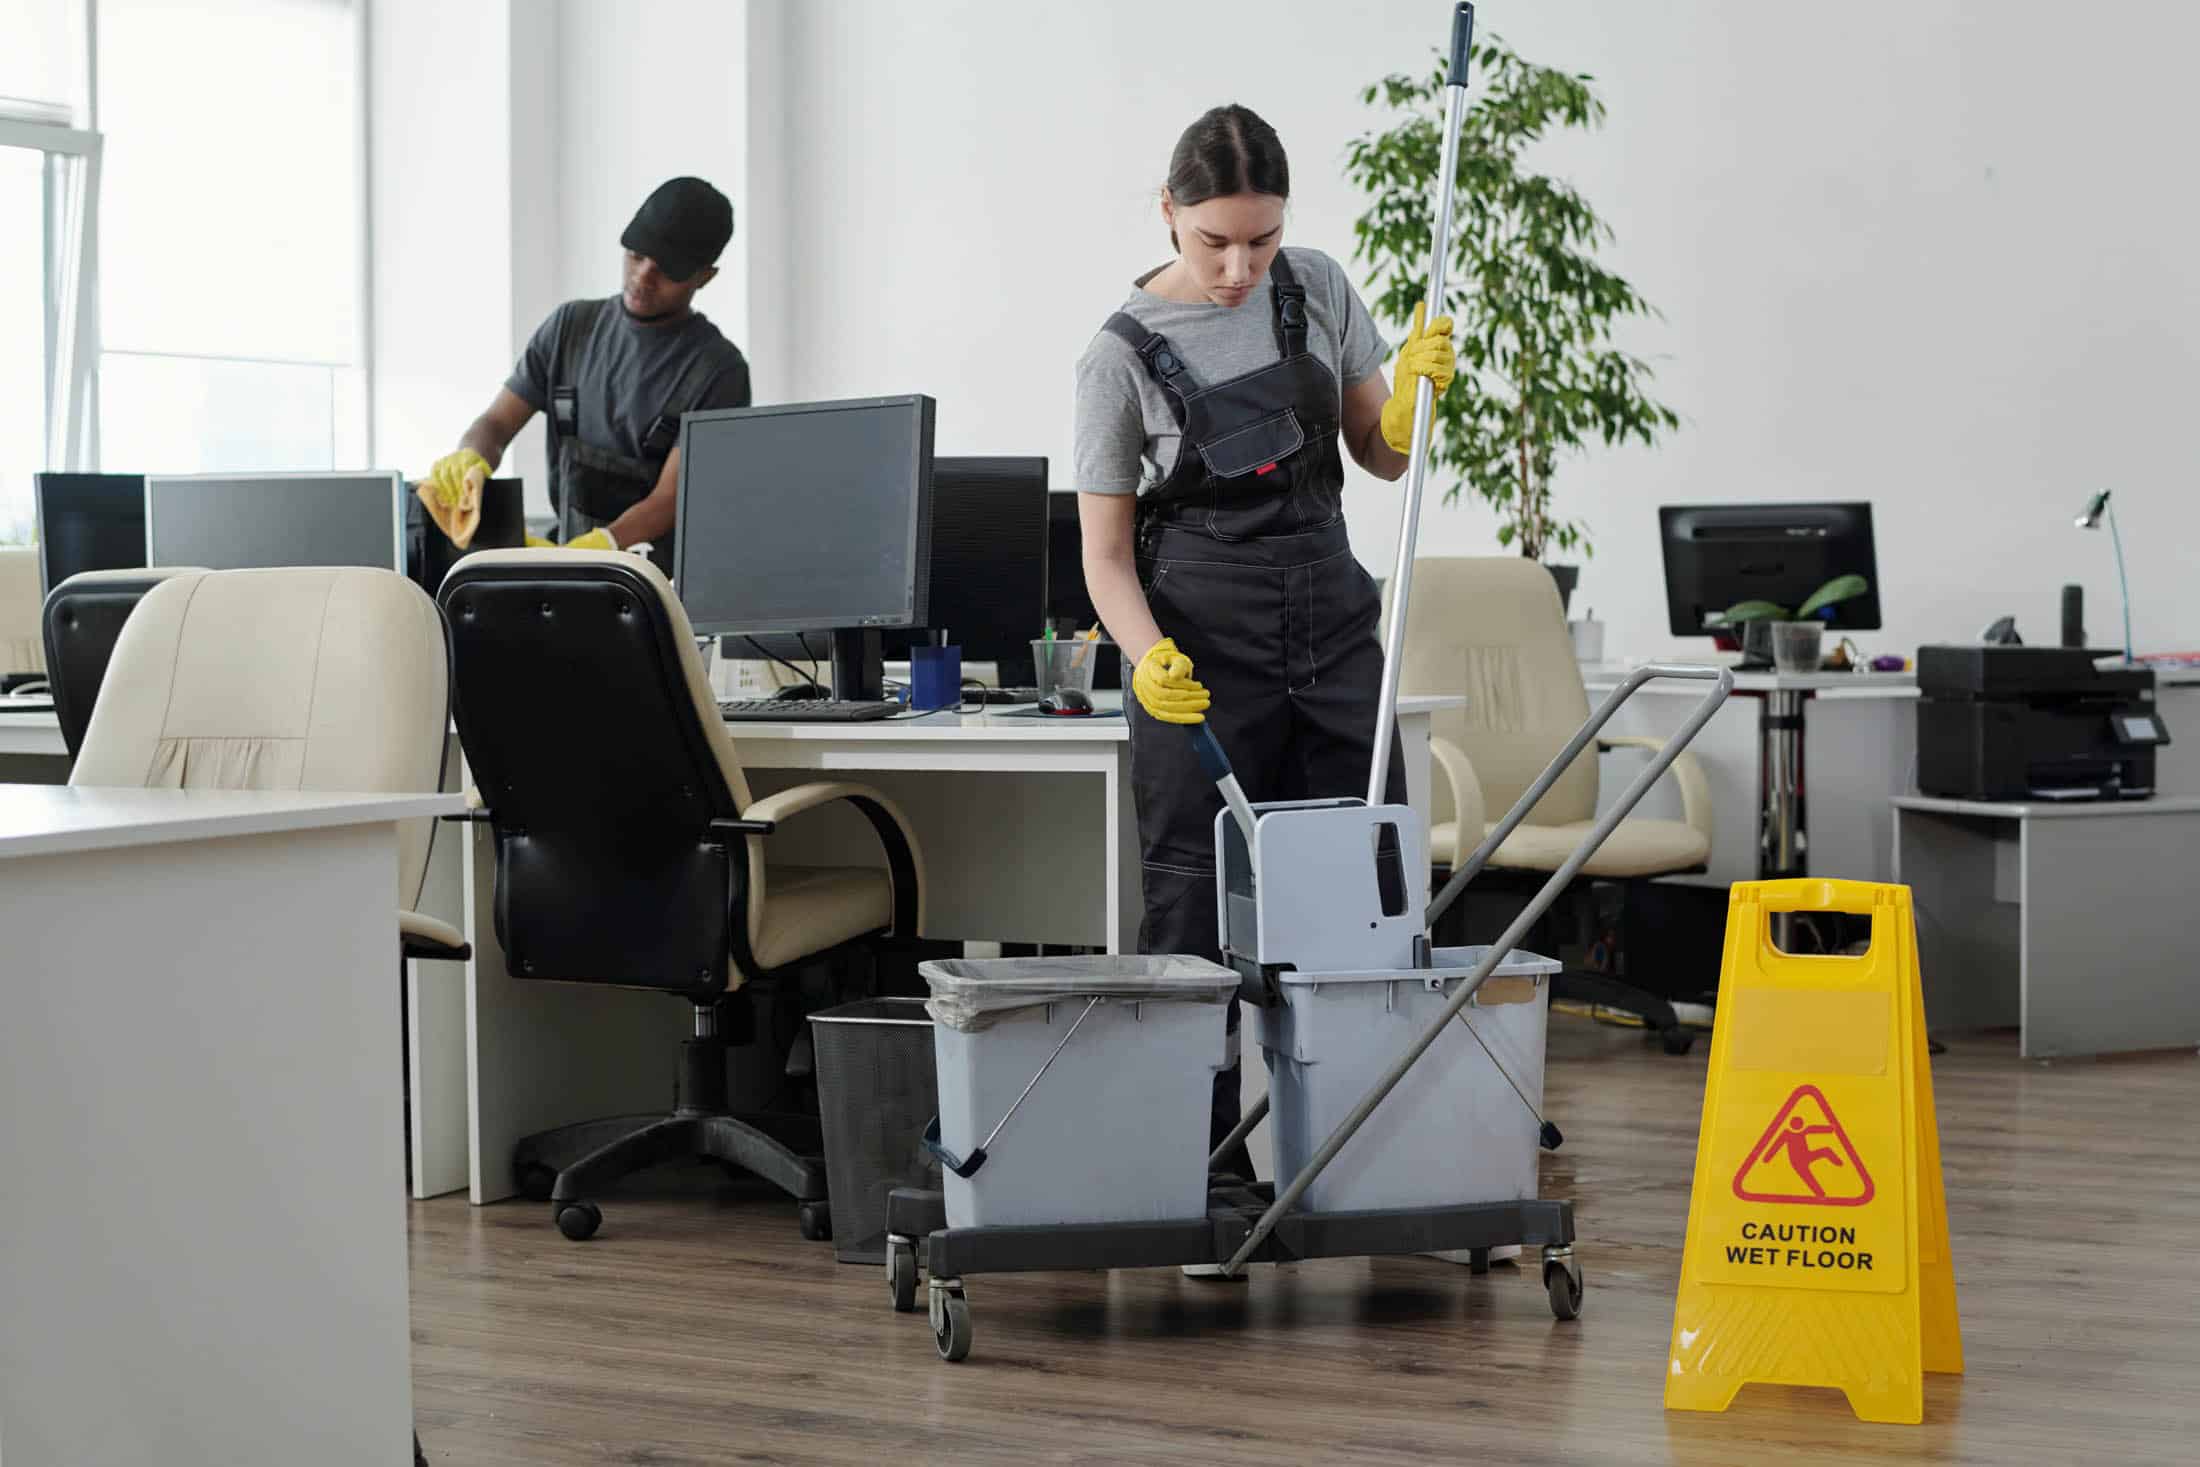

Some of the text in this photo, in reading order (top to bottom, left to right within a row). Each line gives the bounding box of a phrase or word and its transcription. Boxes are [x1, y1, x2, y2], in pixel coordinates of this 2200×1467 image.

[1742, 1222, 1856, 1245] CAUTION
[1726, 1246, 1873, 1271] WET FLOOR
